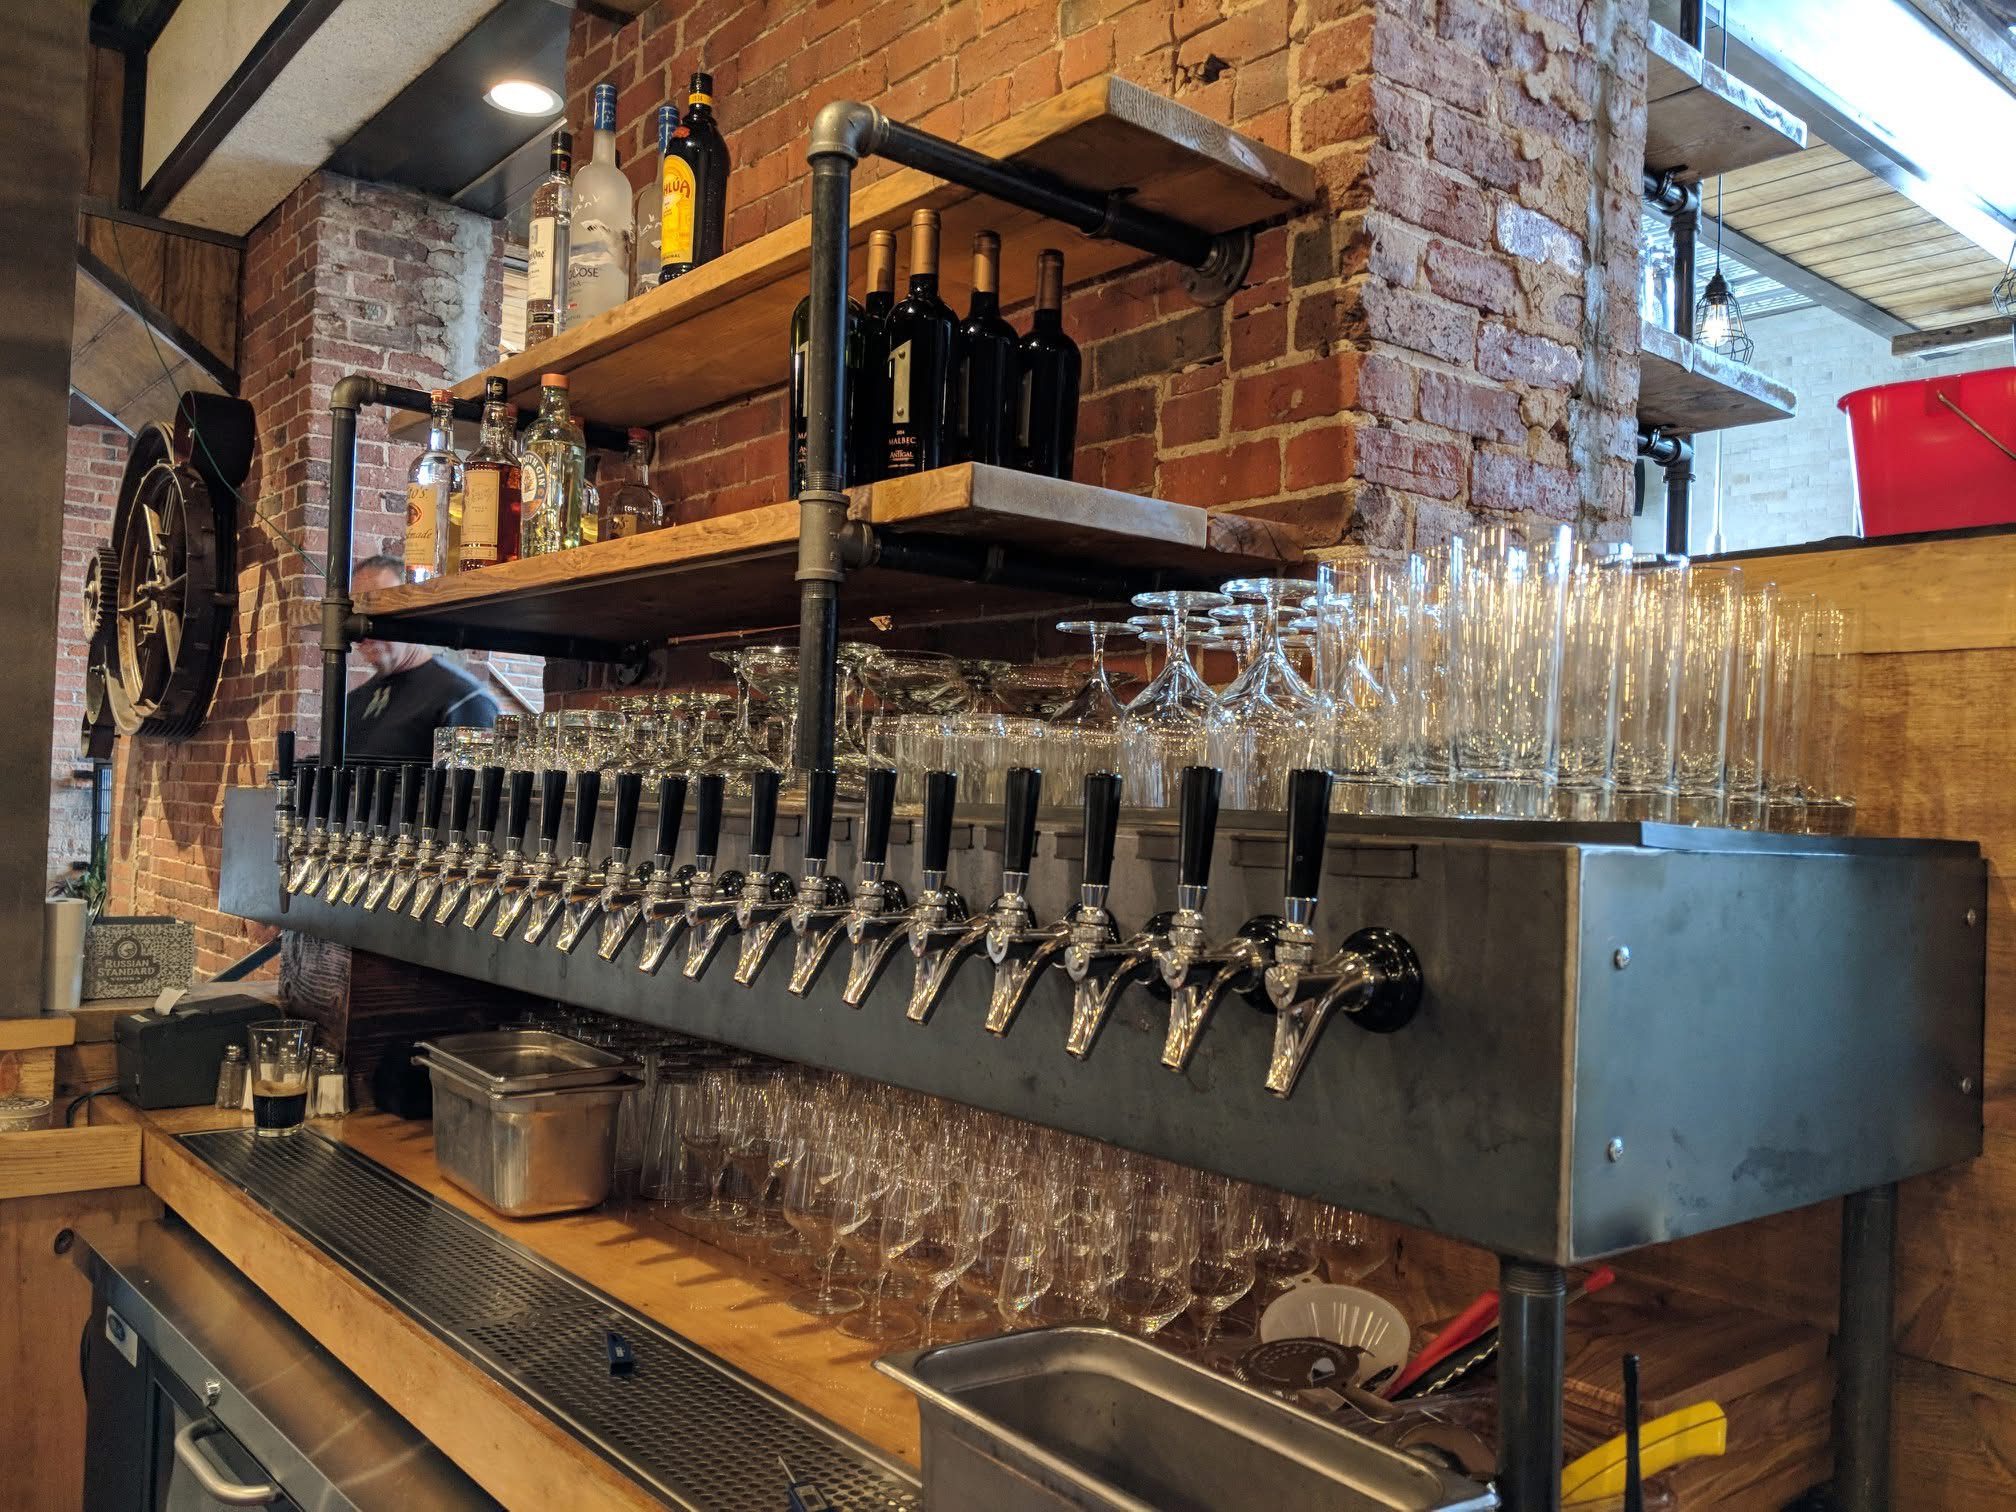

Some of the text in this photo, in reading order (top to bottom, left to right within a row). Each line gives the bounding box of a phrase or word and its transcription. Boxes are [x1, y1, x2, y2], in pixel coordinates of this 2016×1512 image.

[888, 436, 917, 445] MALBEC
[536, 466, 547, 488] GIN
[105, 959, 149, 968] RUSSIAN
[97, 967, 156, 977] STANDARD
